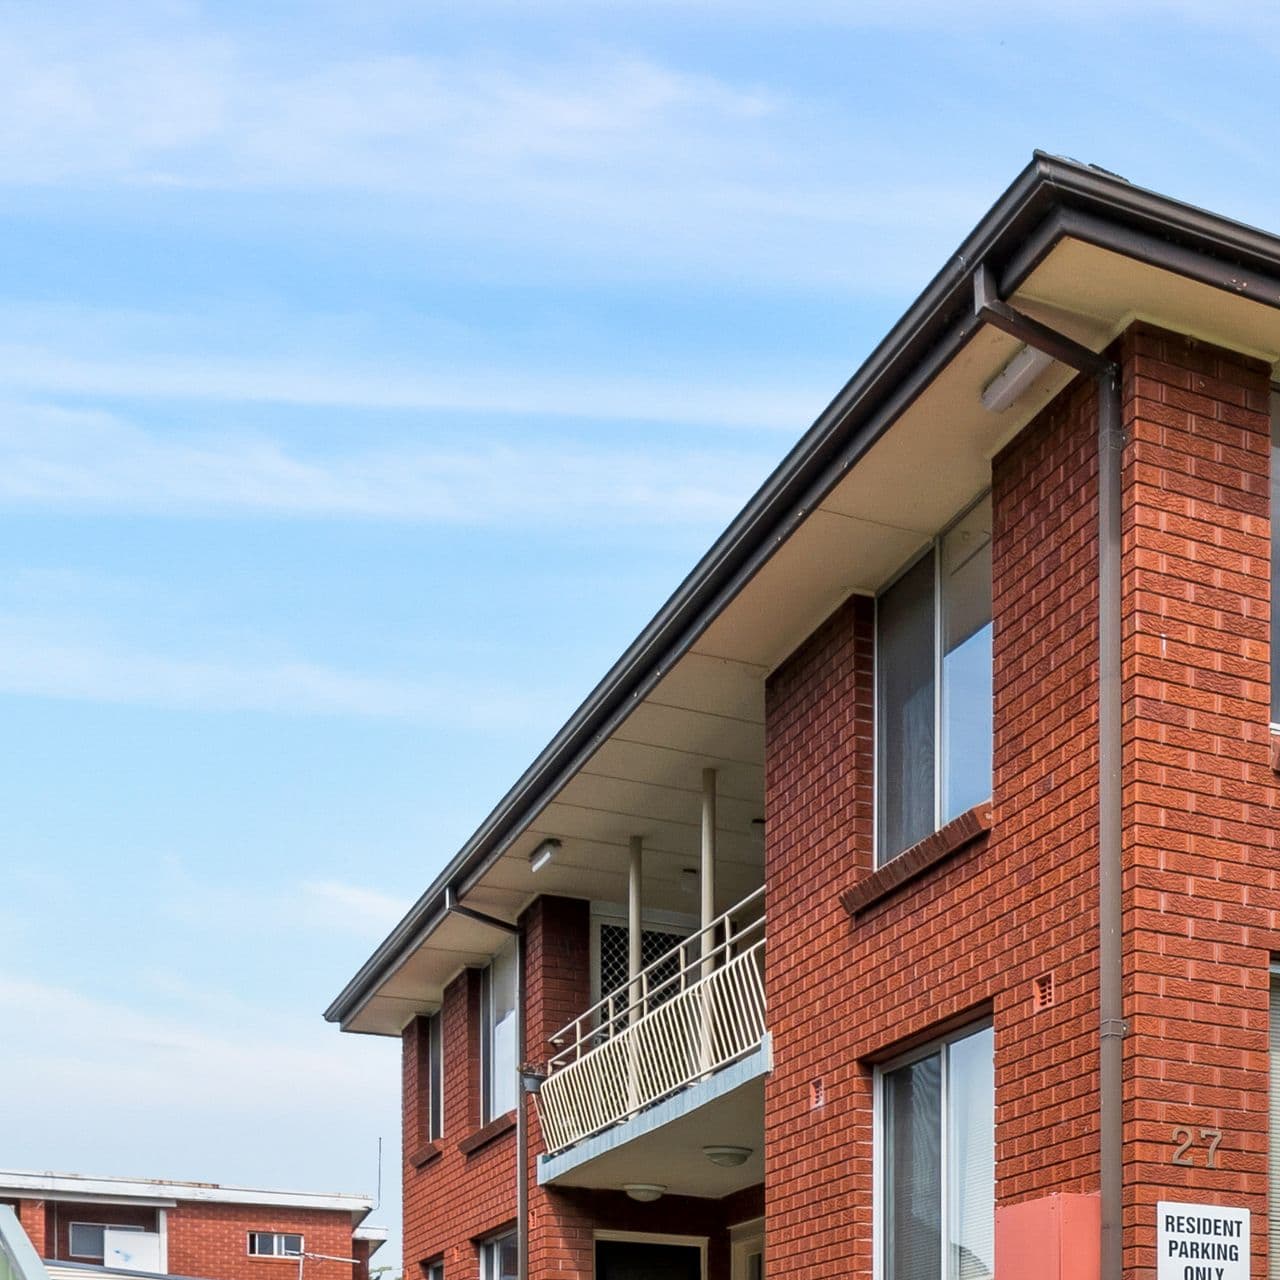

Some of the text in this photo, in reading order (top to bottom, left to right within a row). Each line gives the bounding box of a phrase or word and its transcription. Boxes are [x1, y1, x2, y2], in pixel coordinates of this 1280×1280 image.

[1171, 1127, 1222, 1168] 27
[1165, 1215, 1243, 1238] RESIDENT
[1168, 1240, 1239, 1262] PARKING
